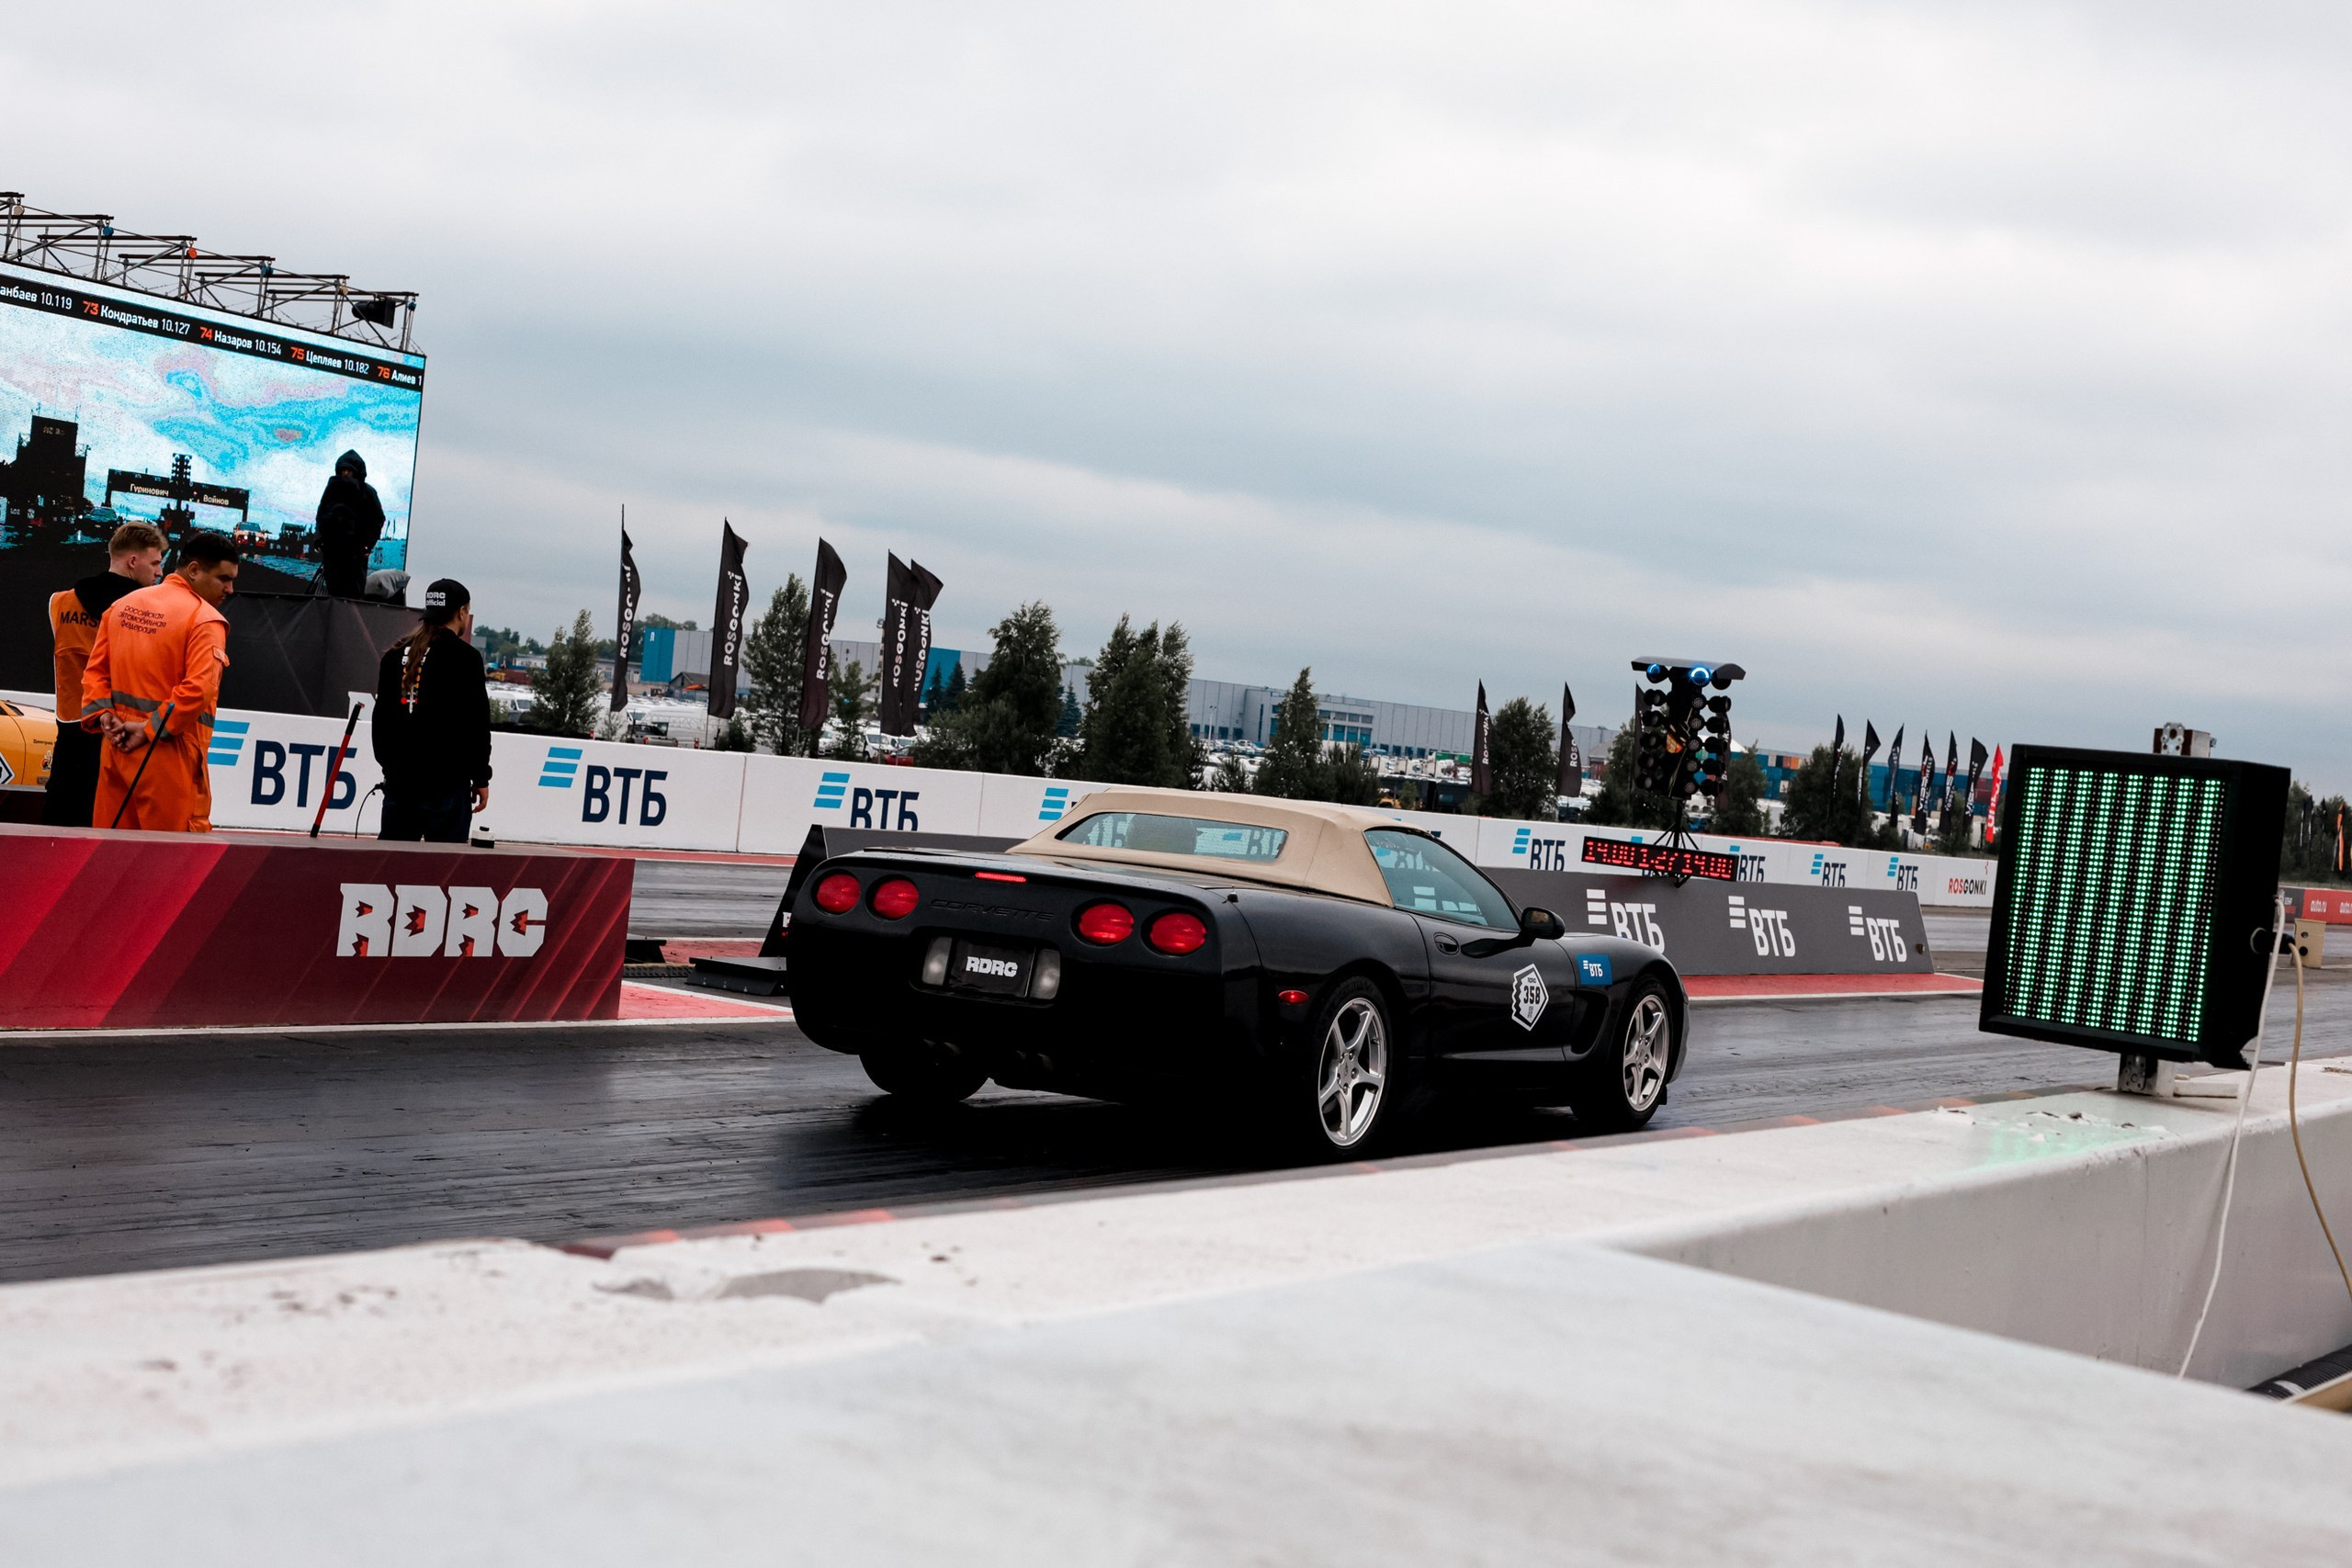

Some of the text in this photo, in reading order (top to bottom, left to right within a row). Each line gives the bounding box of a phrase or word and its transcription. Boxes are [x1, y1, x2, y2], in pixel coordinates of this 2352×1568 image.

[40, 291, 73, 310] 10.119
[83, 299, 99, 316] 73
[100, 304, 159, 329] Кондратьев
[161, 318, 191, 335] 10.127
[199, 326, 212, 341] 74
[214, 330, 253, 350] Назаров
[254, 339, 282, 355] 10.154
[290, 346, 305, 361] 75
[306, 350, 342, 369] Цепляев
[345, 359, 369, 375] 10.182
[378, 366, 390, 379] 76
[391, 369, 416, 385] Алиев
[130, 483, 169, 497] Гуринович
[203, 494, 230, 505] Войнов
[118, 611, 167, 628] автомобильная
[123, 605, 164, 620] российская
[723, 574, 742, 666] ROSGONKI
[120, 619, 157, 634] федерация
[913, 609, 930, 692] OSGONKI
[251, 739, 357, 810] ВТБ
[582, 764, 668, 827] ВТБ
[850, 787, 920, 831] ВТБ
[1530, 838, 1566, 872] ВТБ
[1737, 854, 1766, 883] ВТБ
[1821, 862, 1847, 887] ВТБ
[1896, 865, 1918, 891] ВТБ
[1948, 877, 1987, 896] ROSGONKI
[336, 883, 548, 957] RDRC
[930, 898, 1055, 922] CORVETTE
[1610, 902, 1666, 955] ВТБ
[1748, 908, 1796, 957] ВТБ
[1866, 917, 1907, 963] ВТБ
[966, 956, 1018, 977] RDRC
[1589, 963, 1603, 977] ВТБ
[1523, 985, 1541, 1005] 358
